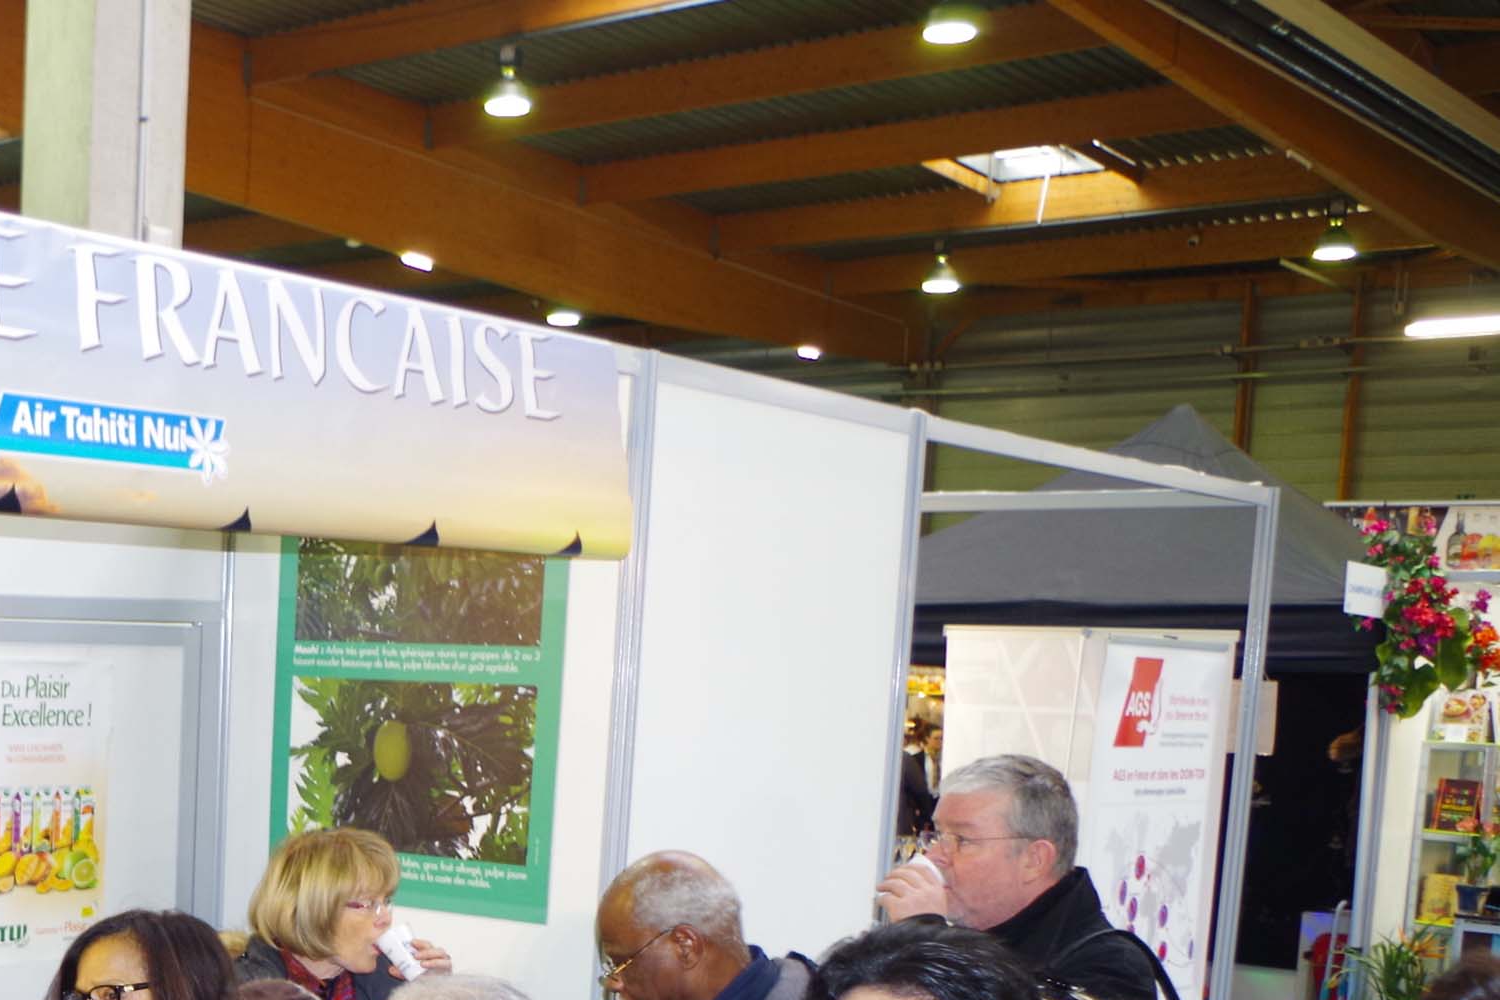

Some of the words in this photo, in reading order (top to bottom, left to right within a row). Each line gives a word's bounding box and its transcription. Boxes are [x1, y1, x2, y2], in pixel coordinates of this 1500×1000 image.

[65, 243, 562, 421] FRANCAISE
[12, 401, 56, 437] Air
[60, 405, 136, 447] Tahiti
[142, 419, 188, 453] Nui
[0, 679, 20, 699] Du
[25, 672, 71, 699] Plaisir
[1125, 691, 1152, 717] AGS
